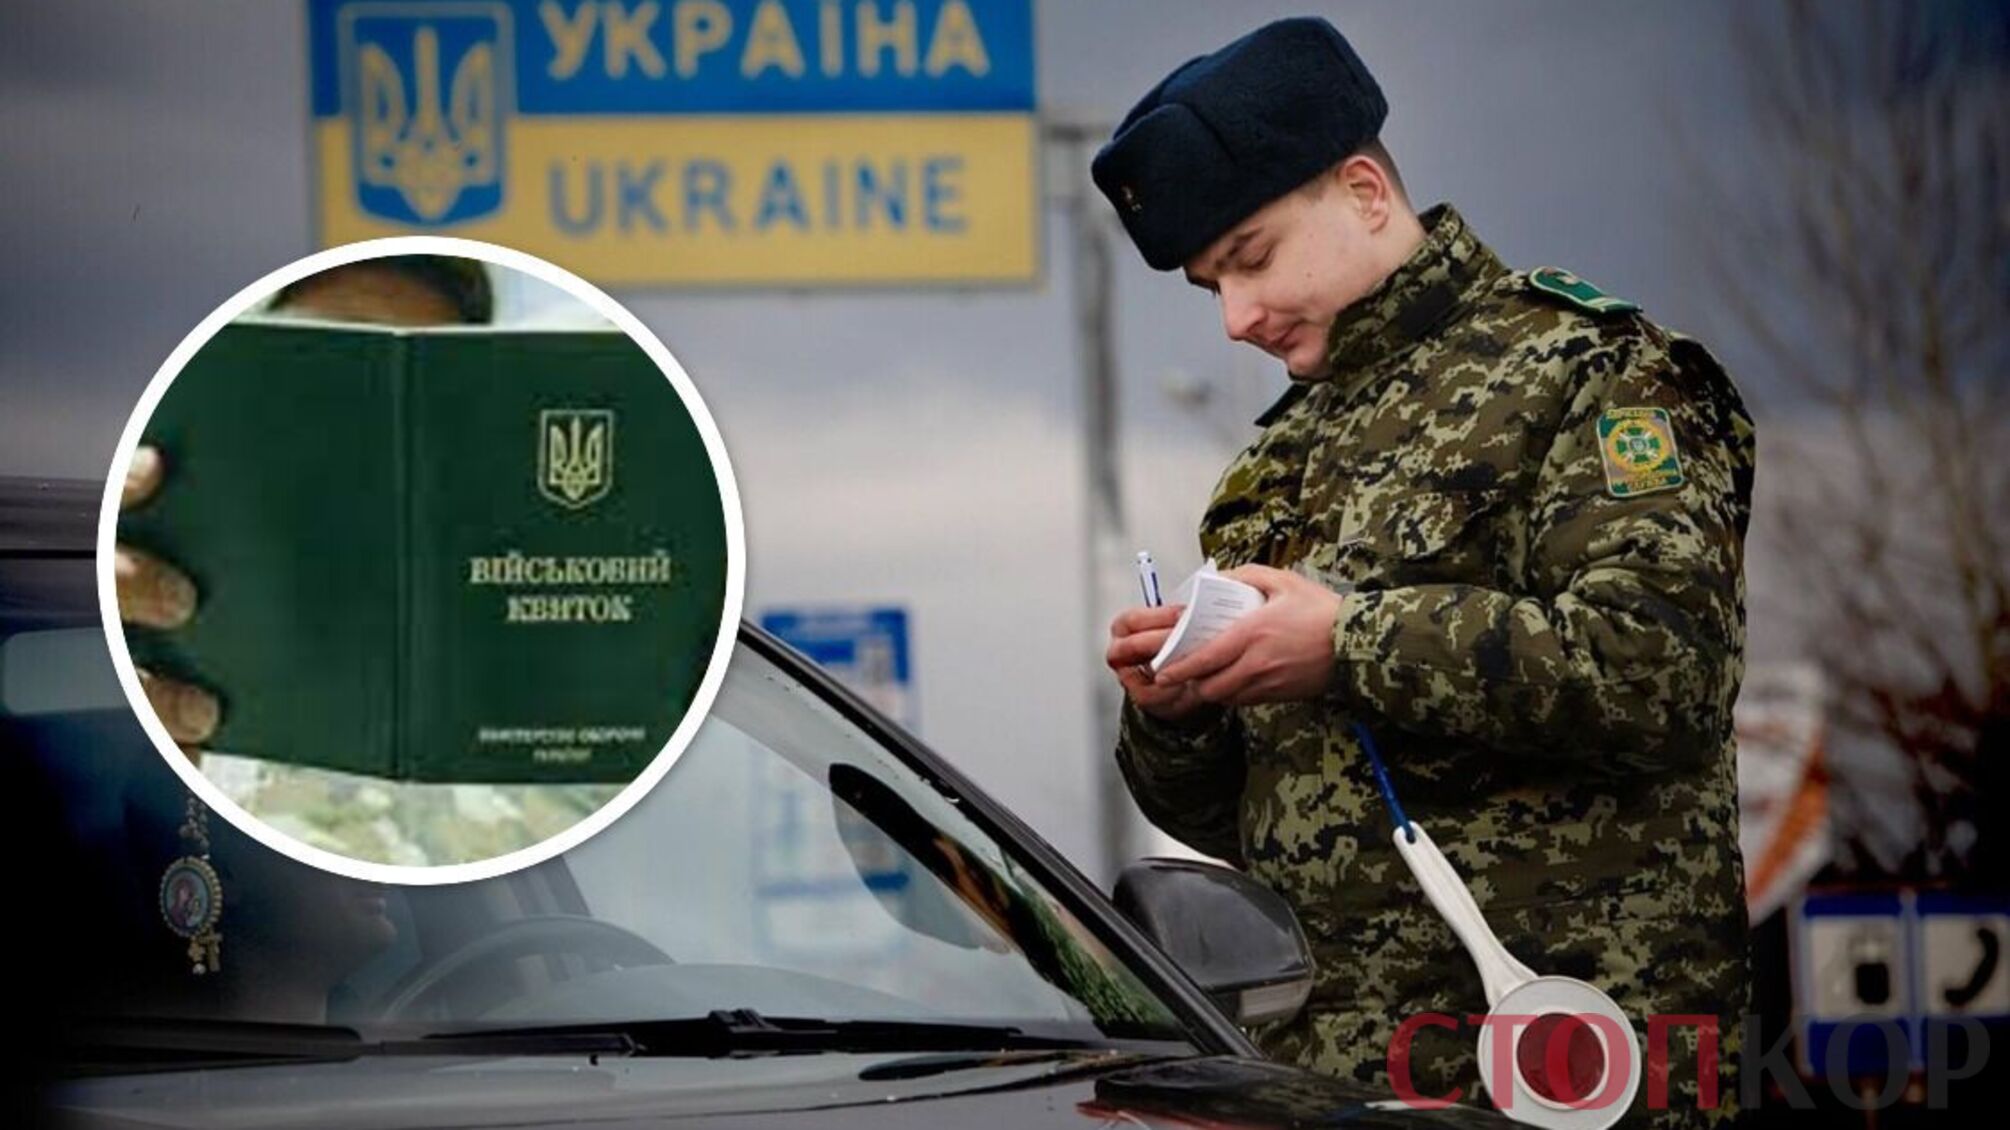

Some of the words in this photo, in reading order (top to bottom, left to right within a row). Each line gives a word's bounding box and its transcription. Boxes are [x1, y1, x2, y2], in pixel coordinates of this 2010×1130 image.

[548, 157, 969, 236] UKRAINE
[470, 550, 671, 584] ВІЙСЬКОВИЙ
[507, 595, 633, 622] КВИТОК
